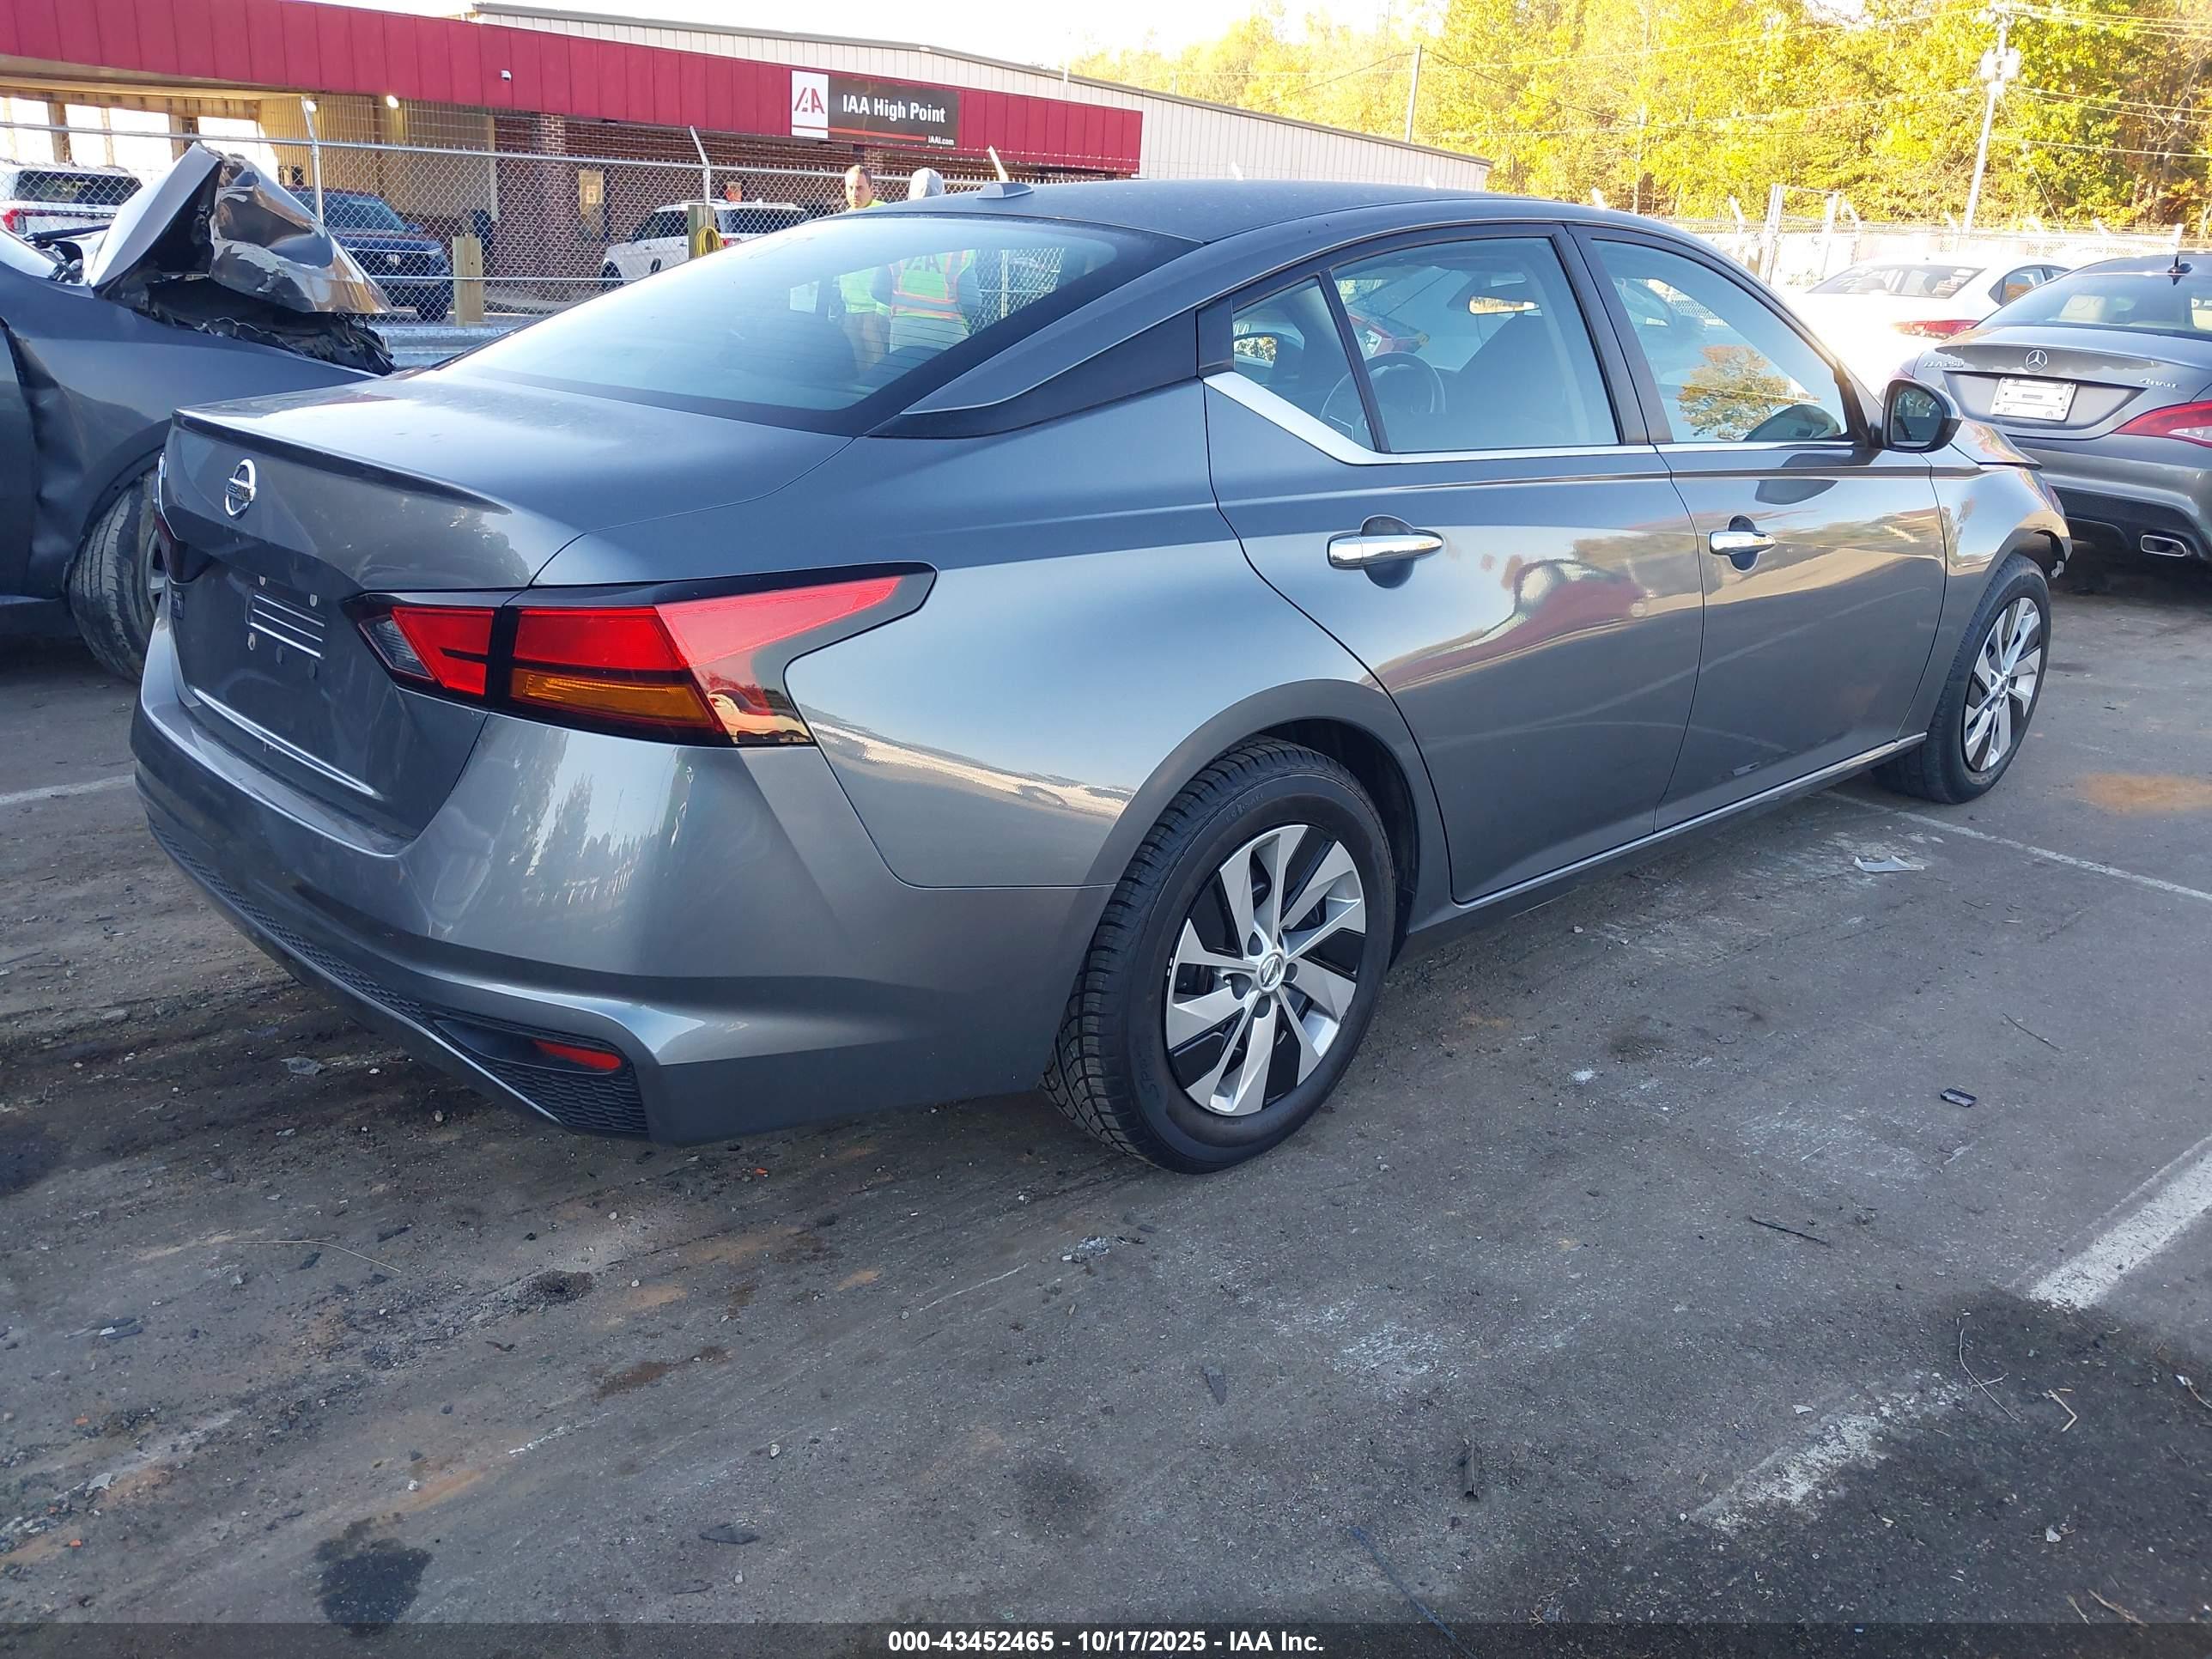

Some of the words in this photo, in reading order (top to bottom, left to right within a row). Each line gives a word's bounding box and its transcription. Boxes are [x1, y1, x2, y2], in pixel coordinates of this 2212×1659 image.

[842, 94, 871, 115] IAA
[873, 98, 906, 122] High
[910, 102, 946, 123] Point
